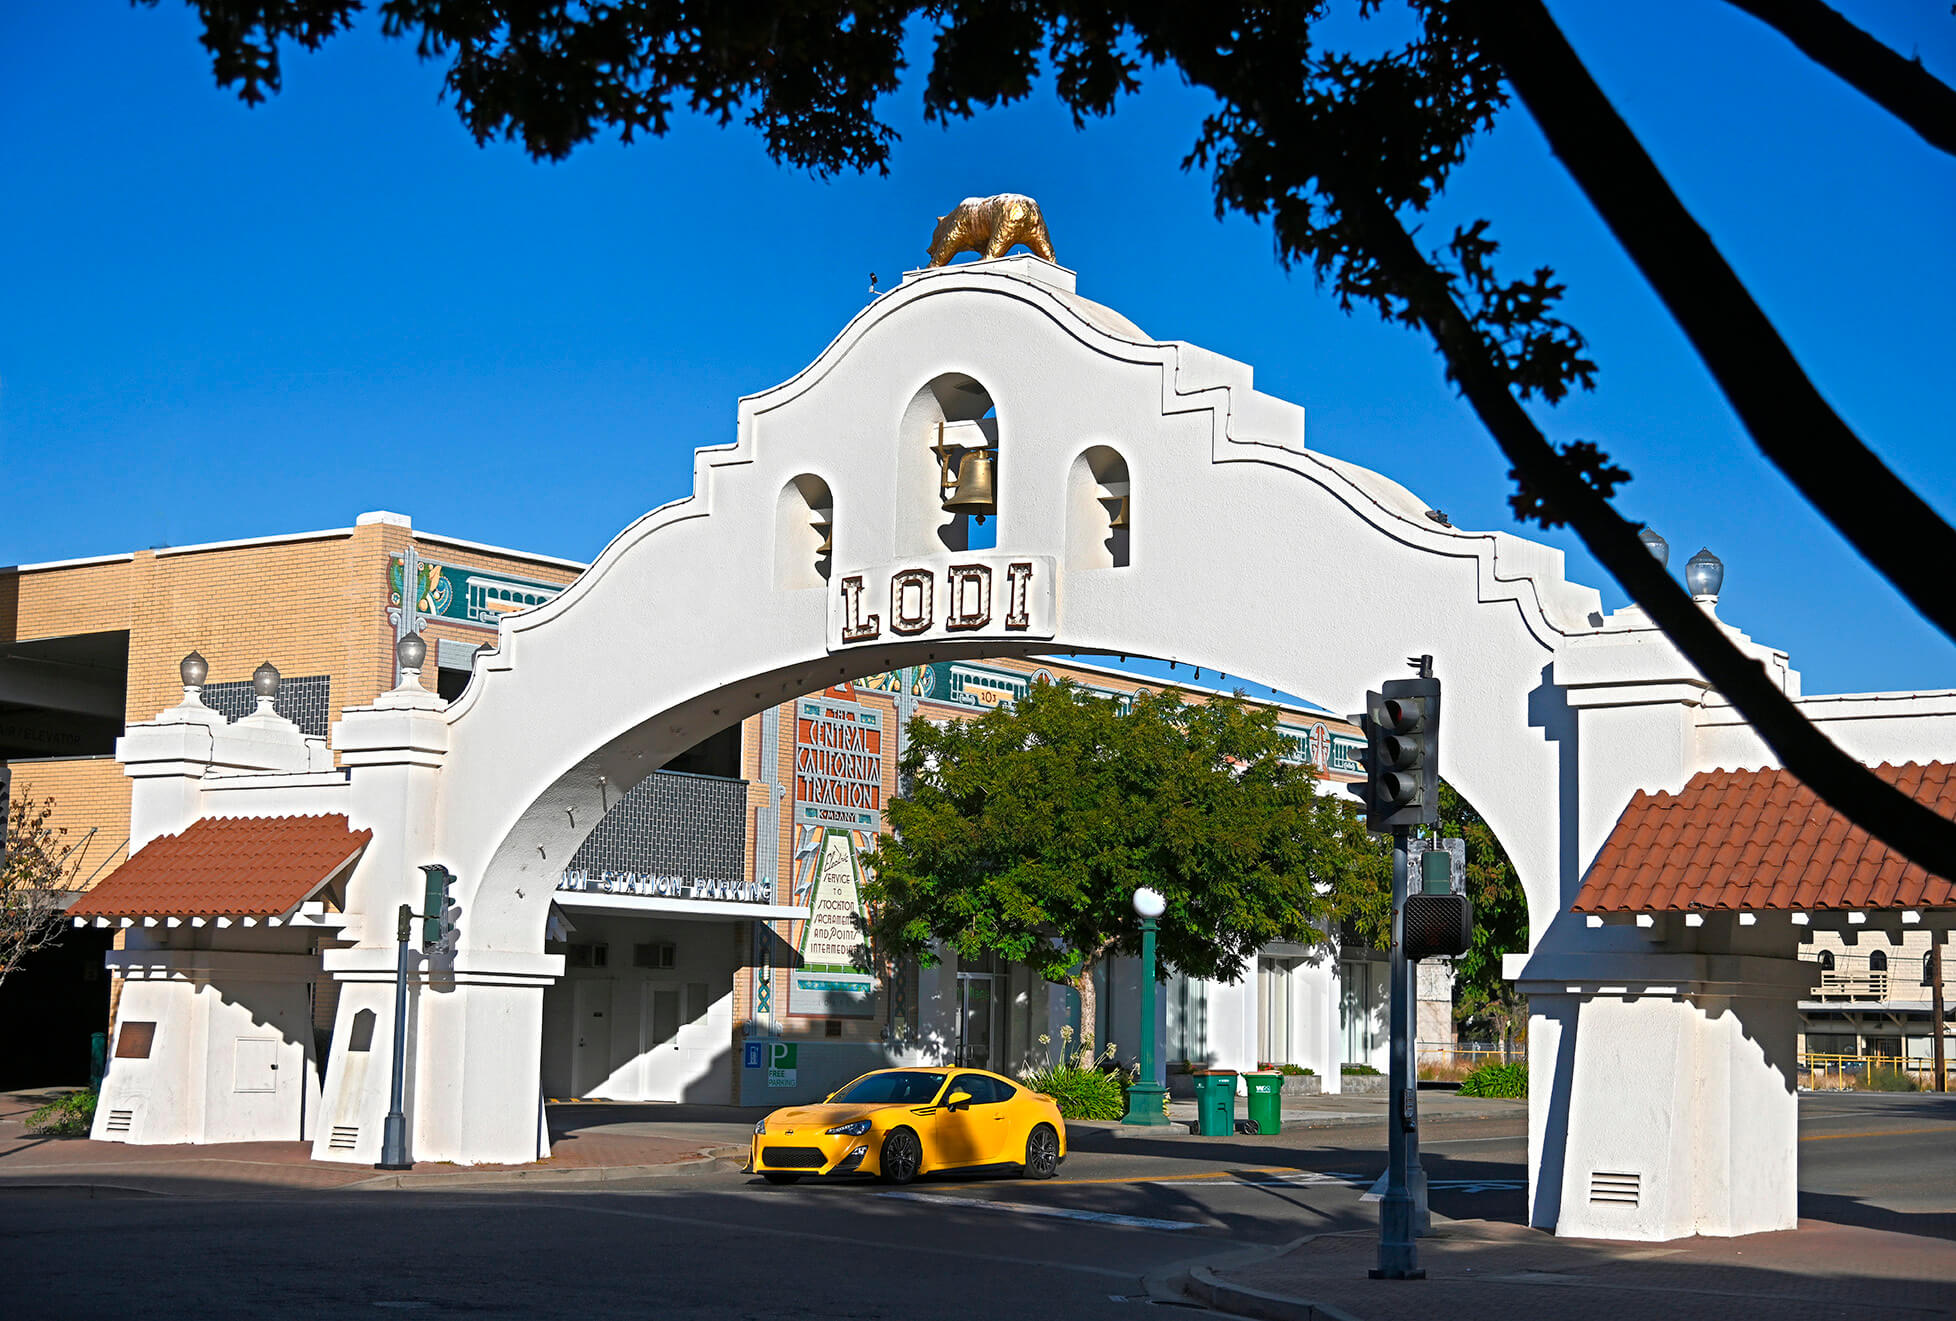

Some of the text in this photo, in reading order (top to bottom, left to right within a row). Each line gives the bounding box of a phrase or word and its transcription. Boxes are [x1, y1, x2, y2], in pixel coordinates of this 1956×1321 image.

[842, 563, 1032, 644] LODI
[981, 692, 997, 703] 103
[831, 707, 849, 721] THE
[810, 720, 870, 753] CENTRAL
[798, 747, 880, 783] CALIFORNIA
[803, 775, 872, 809] TRACTION
[823, 873, 850, 884] SERVICE
[602, 871, 682, 897] STATION
[695, 877, 773, 900] PARKING
[817, 900, 855, 911] STOCKTON
[814, 914, 851, 926] SACRAMEN
[814, 927, 857, 940] AND POINTS
[769, 1042, 788, 1069] P
[768, 1070, 784, 1078] FREE
[768, 1079, 797, 1087] PARKING
